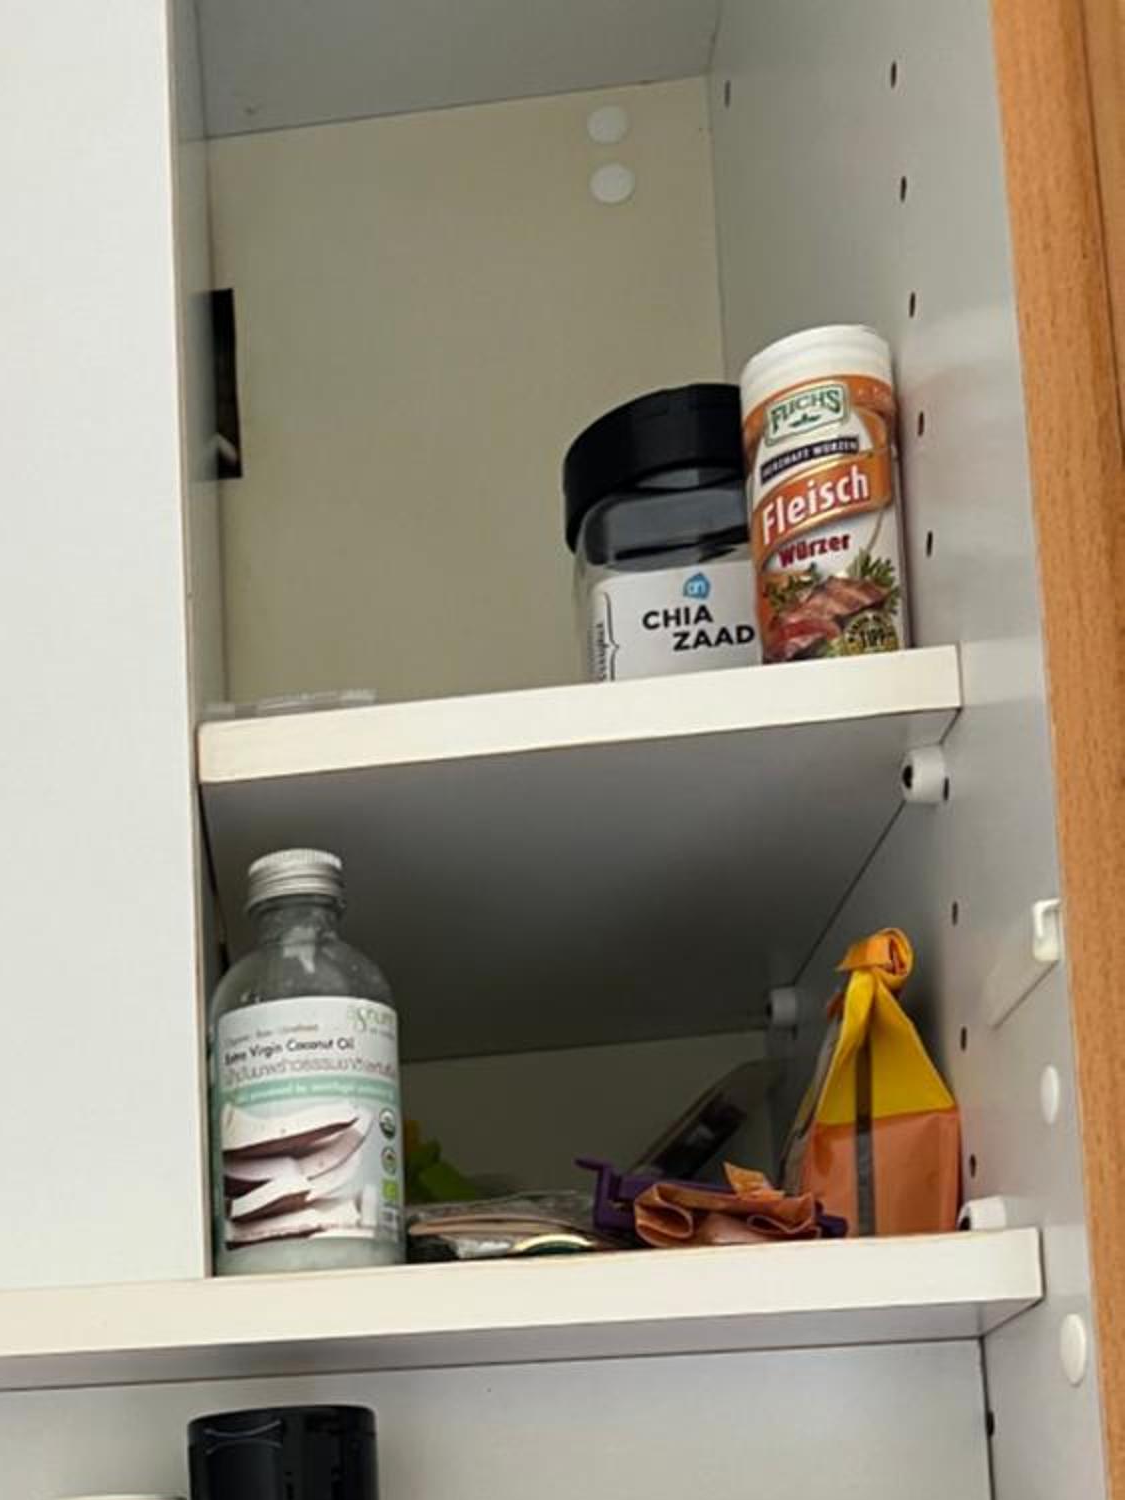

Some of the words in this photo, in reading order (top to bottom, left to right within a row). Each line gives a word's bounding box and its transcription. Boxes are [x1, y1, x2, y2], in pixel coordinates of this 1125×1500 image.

[770, 388, 842, 434] FUCHS
[762, 465, 870, 546] Fleisch
[777, 533, 850, 568] Würzer
[641, 604, 714, 631] CHIA
[672, 624, 756, 652] ZAAD
[249, 1043, 283, 1058] Virgin
[286, 1037, 334, 1051] Coconut
[336, 1036, 354, 1050] Oil
